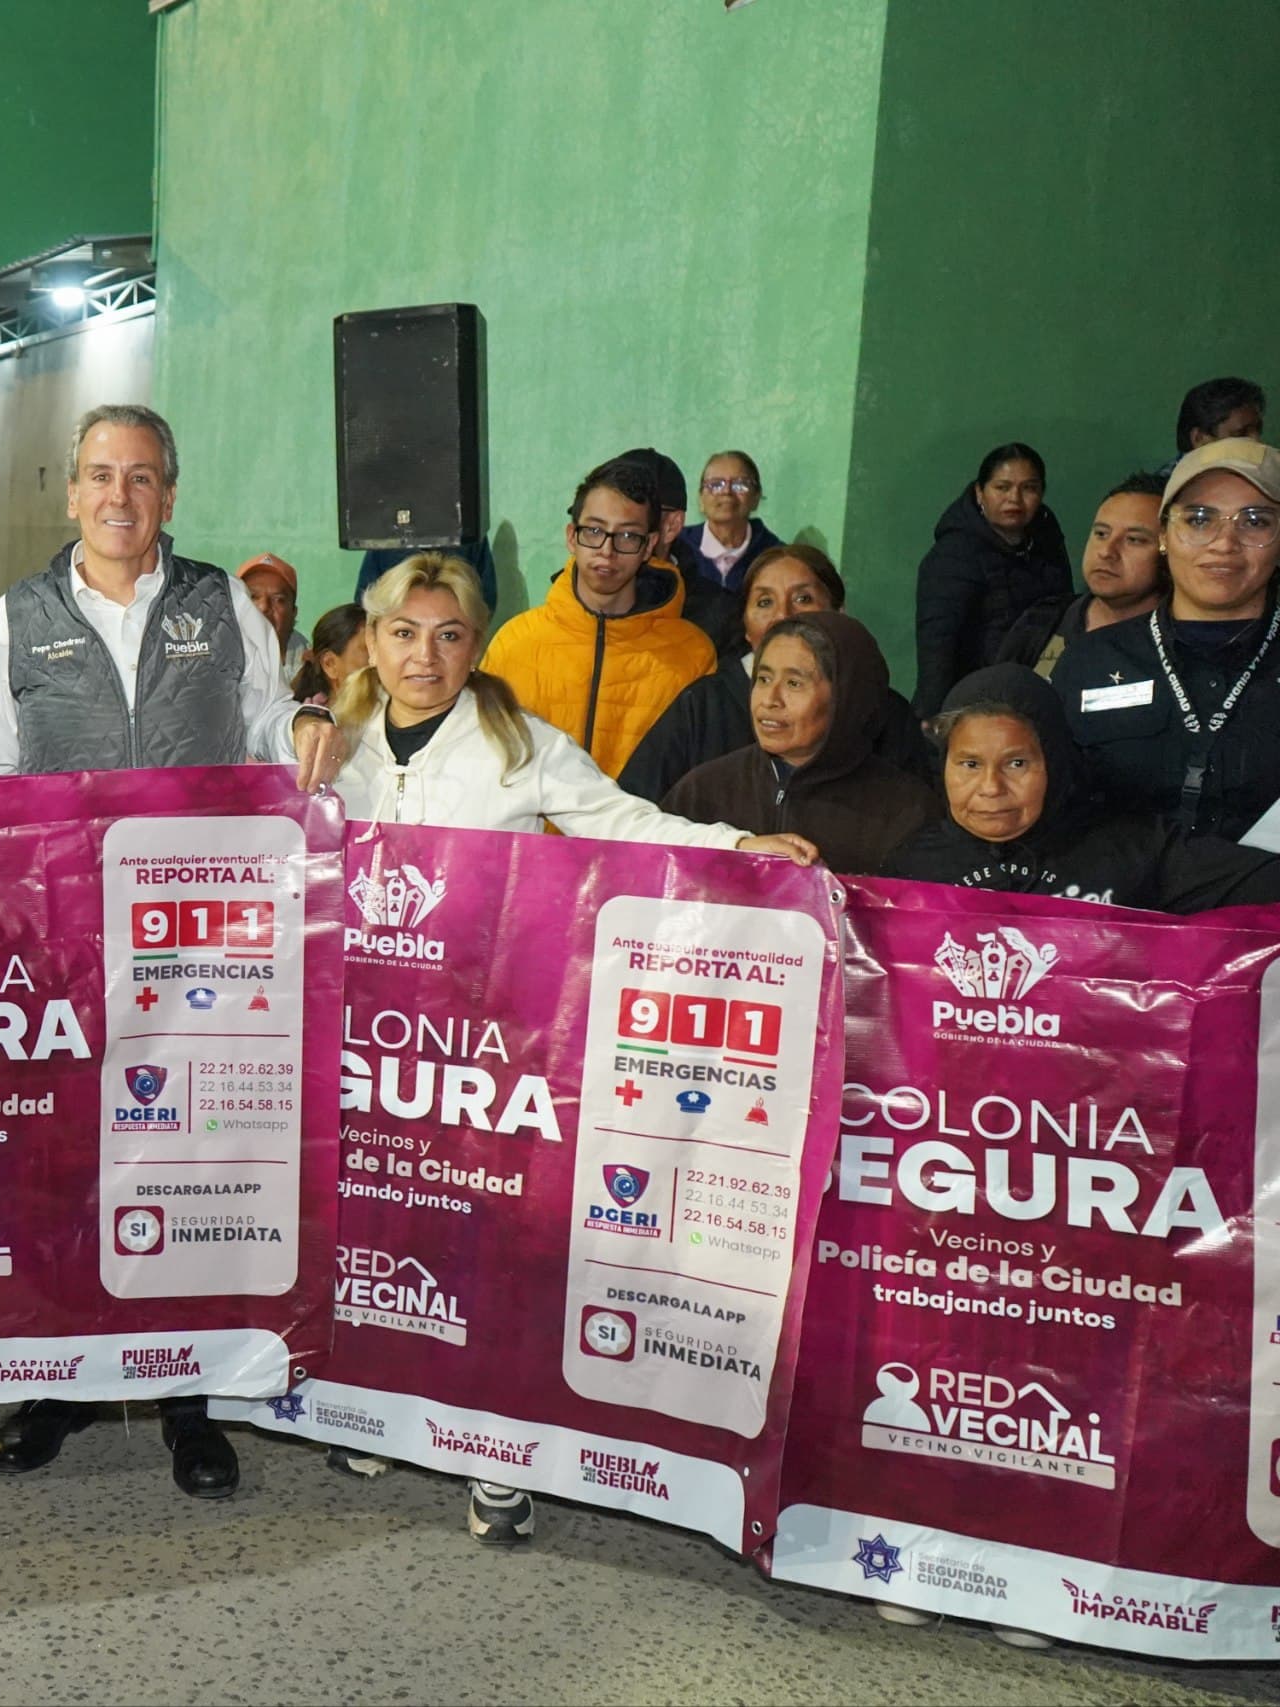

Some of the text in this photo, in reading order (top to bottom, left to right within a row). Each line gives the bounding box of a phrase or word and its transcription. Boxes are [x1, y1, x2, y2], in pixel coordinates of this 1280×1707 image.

[165, 639, 209, 654] Puebla
[1168, 673, 1191, 712] CIUDAD
[1223, 671, 1251, 710] CIUDAD
[119, 855, 207, 867] Ante cualquier
[136, 867, 237, 885] REPORTA
[142, 906, 259, 943] 911
[344, 927, 445, 961] Puebla
[612, 936, 804, 967] Ante eventualidad
[132, 963, 275, 982] EMERGENCIAS
[399, 960, 410, 968] LA
[411, 962, 443, 971] CIUDAD
[629, 951, 786, 986] REPORTA AL:
[630, 998, 764, 1046] 911
[932, 1000, 1061, 1037] Puebla
[344, 1005, 510, 1064] LONIA
[200, 1063, 293, 1075] 22.21.92.62.39
[614, 1056, 777, 1092] EMERGENCIAS
[200, 1099, 293, 1111] 22.16.54.58.15
[340, 1049, 563, 1143] GURA
[115, 1107, 177, 1121] DGERI
[223, 1119, 289, 1132] Whatsapp
[839, 1082, 1155, 1155] COLONIA
[339, 1124, 432, 1156] Vecinos y
[346, 1148, 523, 1196] de la Ciudad
[687, 1170, 791, 1199] 22.21.92.62.39
[824, 1133, 1233, 1242] EGURA
[136, 1183, 262, 1196] DESCARGA LA APP
[337, 1178, 472, 1214] ajando juntos
[130, 1222, 146, 1237] SI
[172, 1215, 256, 1226] SEGURIDAD
[589, 1205, 657, 1227] DGERI
[683, 1208, 787, 1240] 22.16.54.58.15
[171, 1227, 282, 1243] INMEDIATA
[708, 1235, 781, 1261] Whatsapp
[929, 1228, 1057, 1263] Vecinos y
[336, 1245, 396, 1278] RED
[818, 1239, 1183, 1307] Policía de la Ciudad
[334, 1277, 467, 1324] VECINAL
[607, 1287, 746, 1324] DESCARGA LA APP
[872, 1283, 1117, 1330] trabajando juntos
[362, 1311, 445, 1334] VIGILANTE
[598, 1325, 616, 1341] SI
[122, 1346, 191, 1366] PUEBLA
[645, 1326, 737, 1356] SEGURIDAD
[9, 1360, 68, 1368] CAPITAL
[136, 1361, 201, 1379] SEGURA
[644, 1338, 761, 1381] INMEDIATA
[929, 1367, 1016, 1410] RED
[316, 1407, 385, 1429] SEGURIDAD
[316, 1416, 385, 1438] CIUDADANA
[930, 1403, 1115, 1464] VECINAL
[433, 1435, 532, 1467] IMPARABLE
[440, 1428, 523, 1452] LA CAPITAL
[888, 1433, 1085, 1477] VECINO VIGILANTE
[580, 1448, 656, 1478] PUEBLA
[596, 1469, 669, 1500] SEGURA
[917, 1574, 1007, 1600] CIUDADANA
[918, 1561, 1007, 1589] SEGURIDAD
[1072, 1599, 1208, 1634] IMPARABLE
[1081, 1588, 1198, 1617] LA CAPITAL
